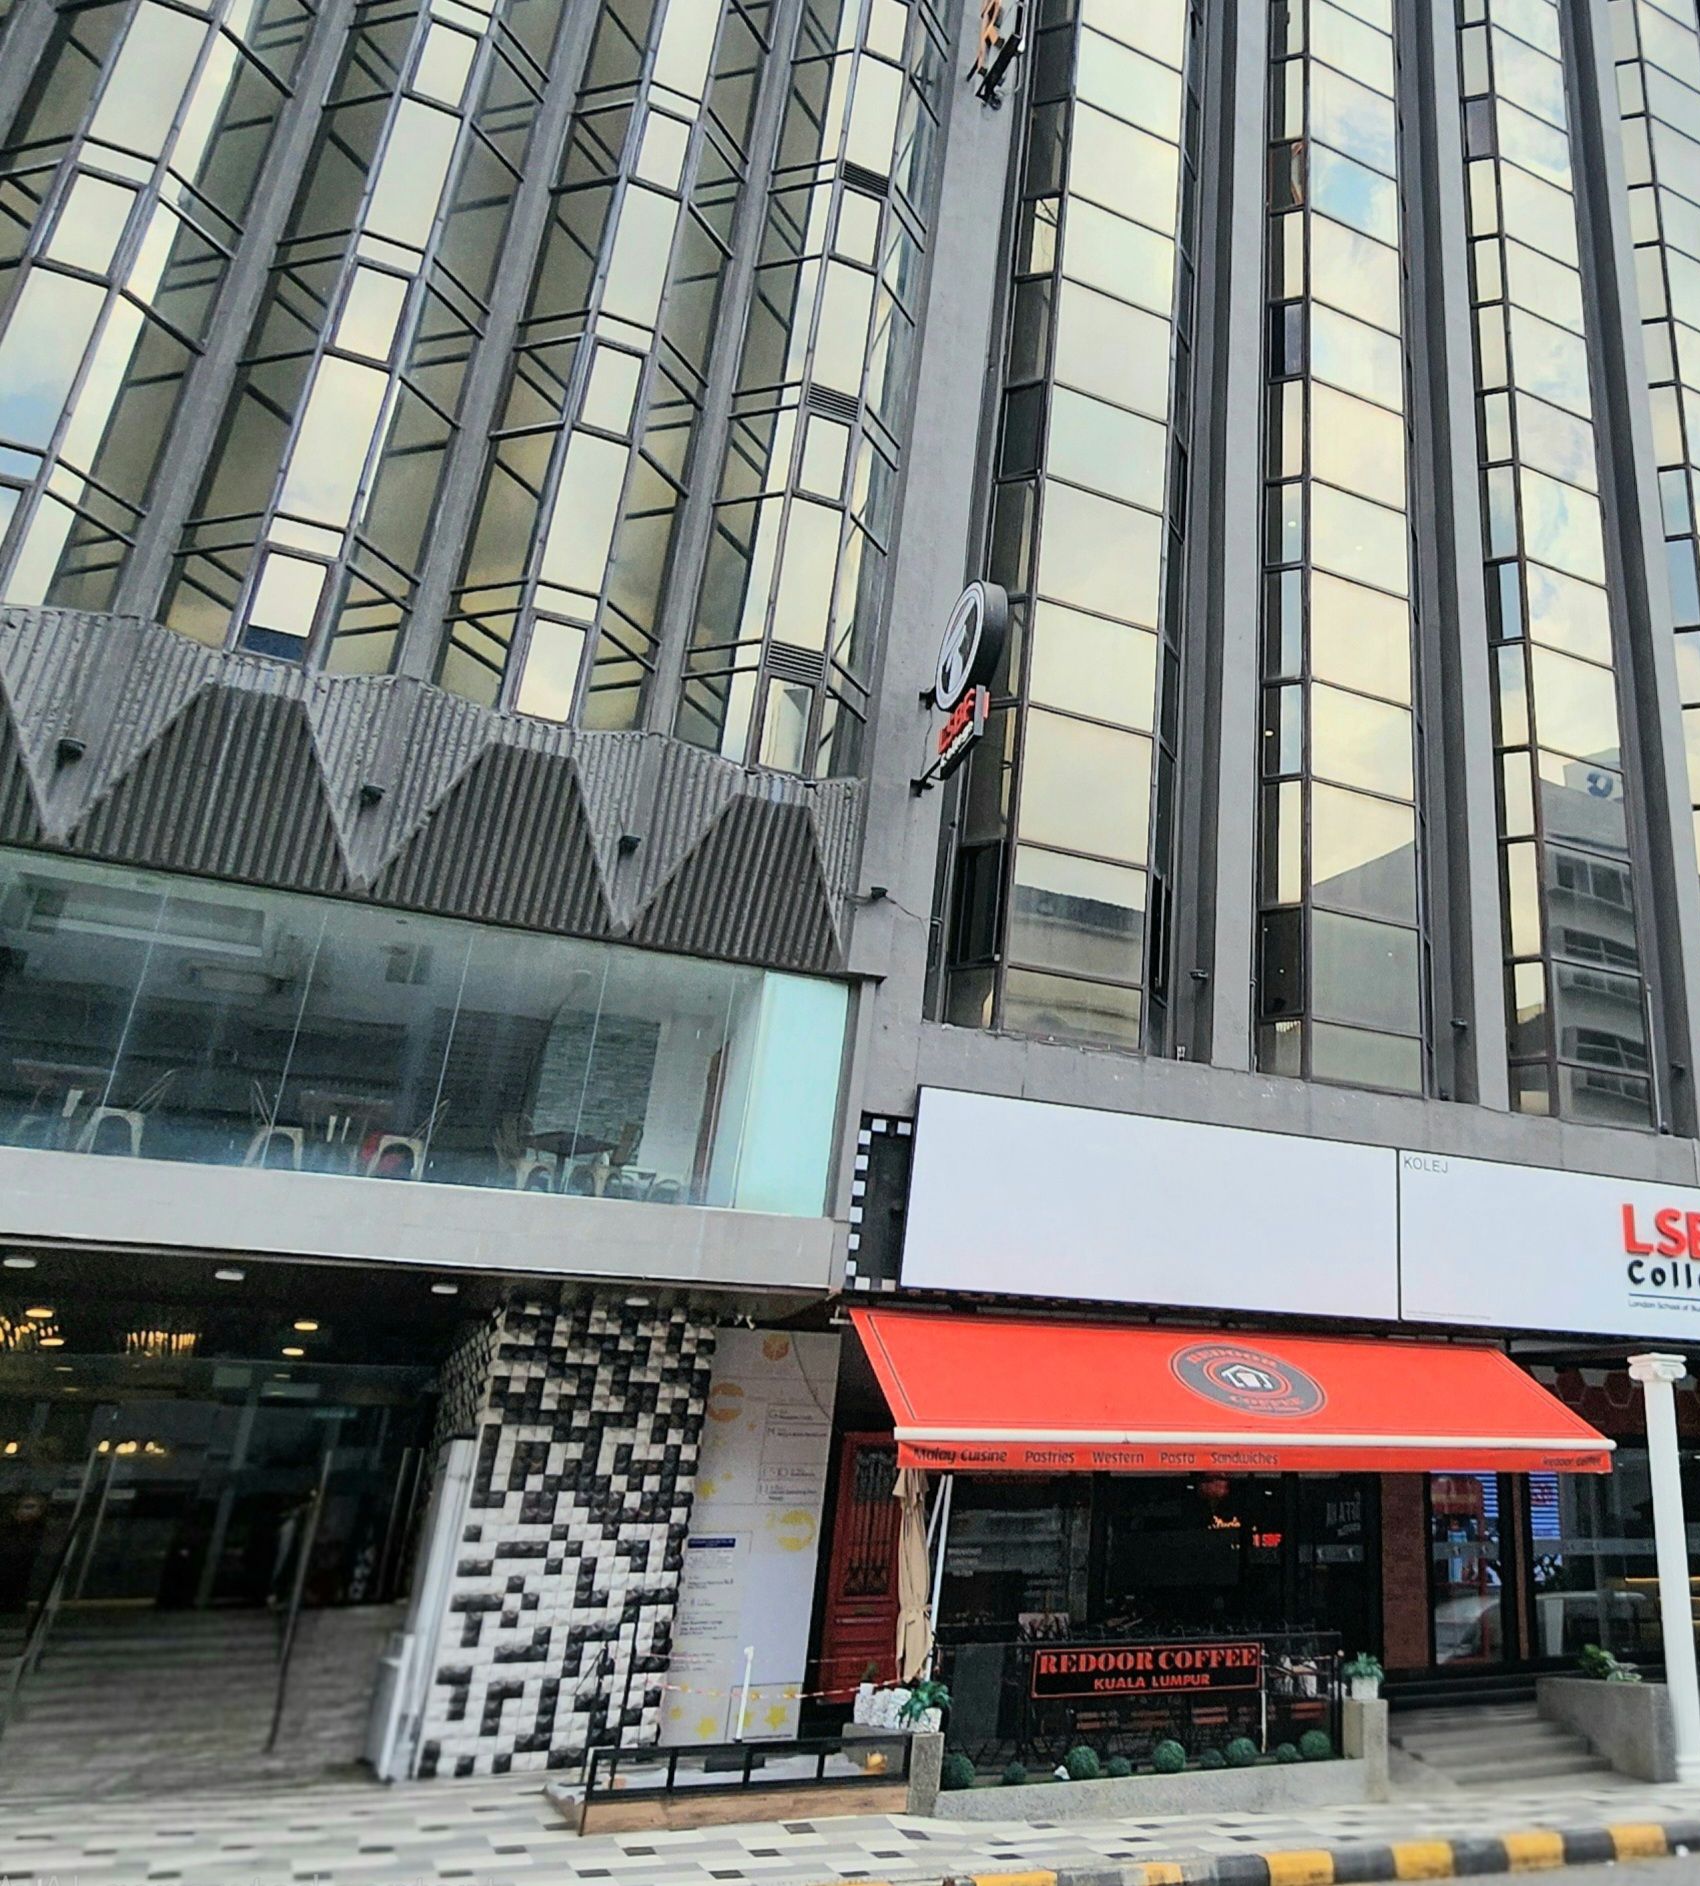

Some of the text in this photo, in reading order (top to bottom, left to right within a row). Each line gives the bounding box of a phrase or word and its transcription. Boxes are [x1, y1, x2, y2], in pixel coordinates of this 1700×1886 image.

[1403, 1156, 1449, 1174] KOLEJ
[1627, 1299, 1656, 1309] London
[1657, 1301, 1680, 1311] School
[913, 1447, 957, 1465] Malay
[960, 1448, 1008, 1462] Cuisine
[1025, 1450, 1075, 1464] Pastries
[1092, 1451, 1145, 1464] Western
[1160, 1452, 1195, 1464] Pasta
[1210, 1451, 1279, 1465] Sandwiches
[1039, 1648, 1258, 1674] REDOOR COFFEE
[1094, 1674, 1211, 1690] KUALA LUMPUR
